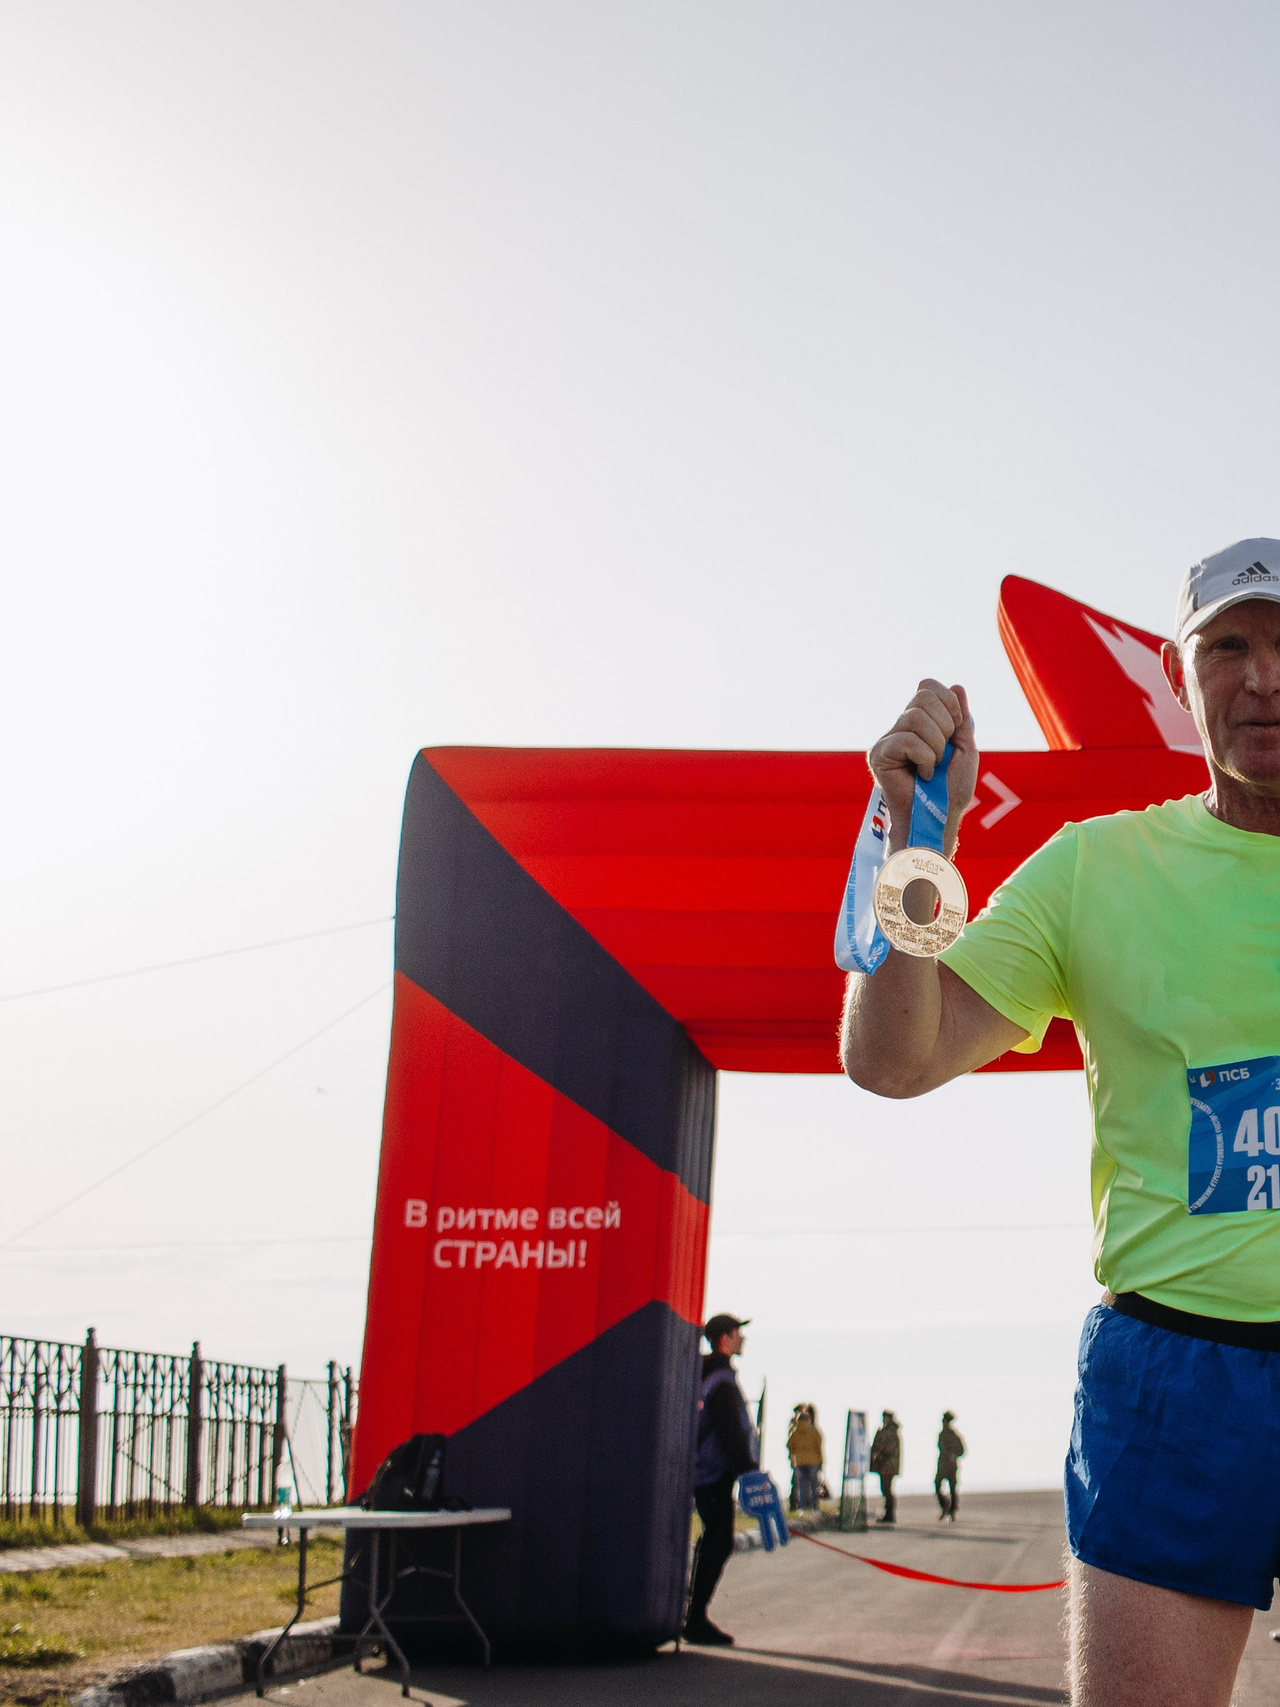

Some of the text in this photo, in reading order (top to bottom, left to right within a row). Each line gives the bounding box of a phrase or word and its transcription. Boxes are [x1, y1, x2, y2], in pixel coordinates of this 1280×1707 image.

[1232, 573, 1279, 586] adidas
[1219, 1068, 1250, 1082] ПСБ
[404, 1198, 621, 1233] В ритме всей
[434, 1239, 588, 1269] СТРАНЫ!
